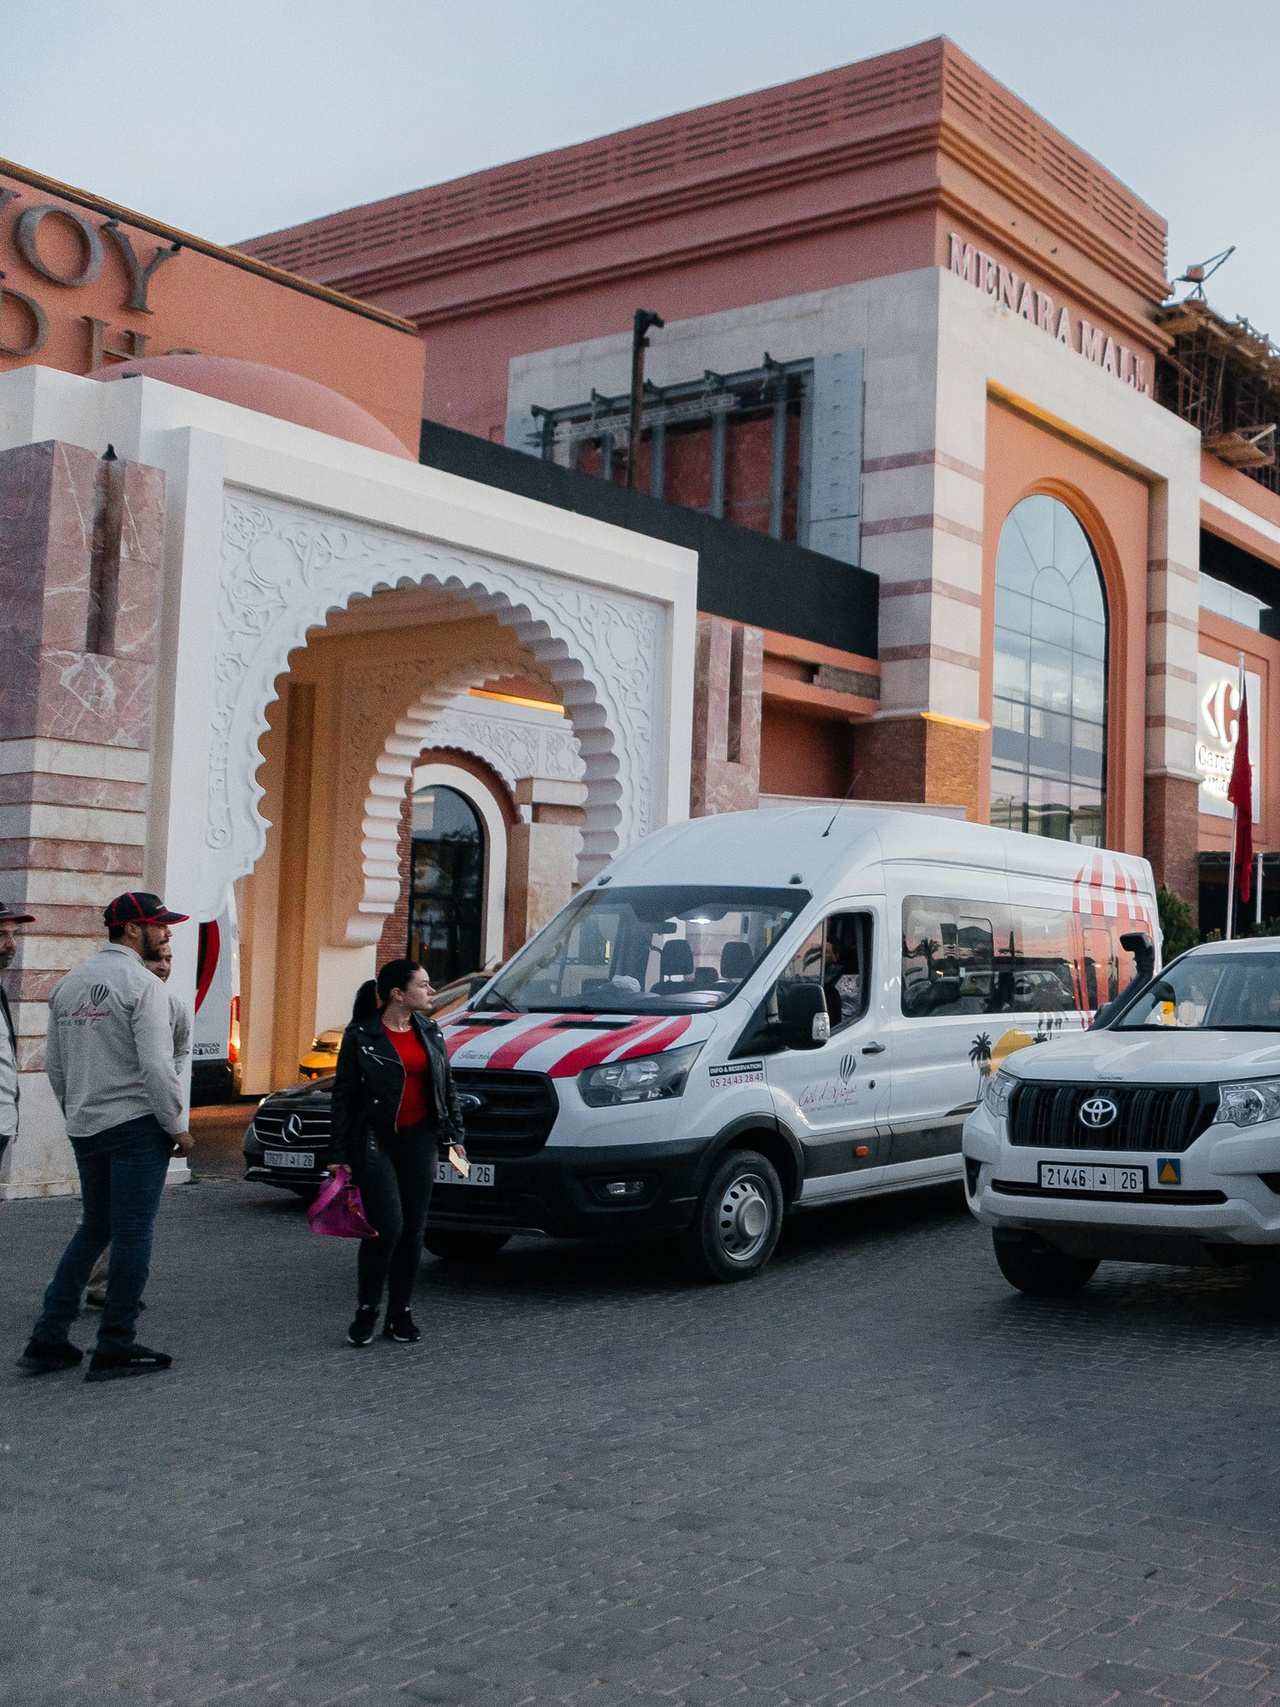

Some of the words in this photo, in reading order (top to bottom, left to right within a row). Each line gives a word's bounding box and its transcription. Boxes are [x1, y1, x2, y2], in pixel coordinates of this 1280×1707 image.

[0, 187, 182, 315] OY
[949, 232, 1074, 354] MENARA
[1080, 319, 1150, 393] MALL
[728, 1063, 762, 1072] RESERVATION
[710, 1078, 720, 1088] 05
[722, 1077, 731, 1086] 24
[734, 1075, 742, 1084] 43
[745, 1074, 753, 1083] 28
[755, 1072, 764, 1081] 43
[477, 1167, 490, 1183] 26
[1047, 1168, 1086, 1187] 21446
[1121, 1171, 1137, 1189] 26
